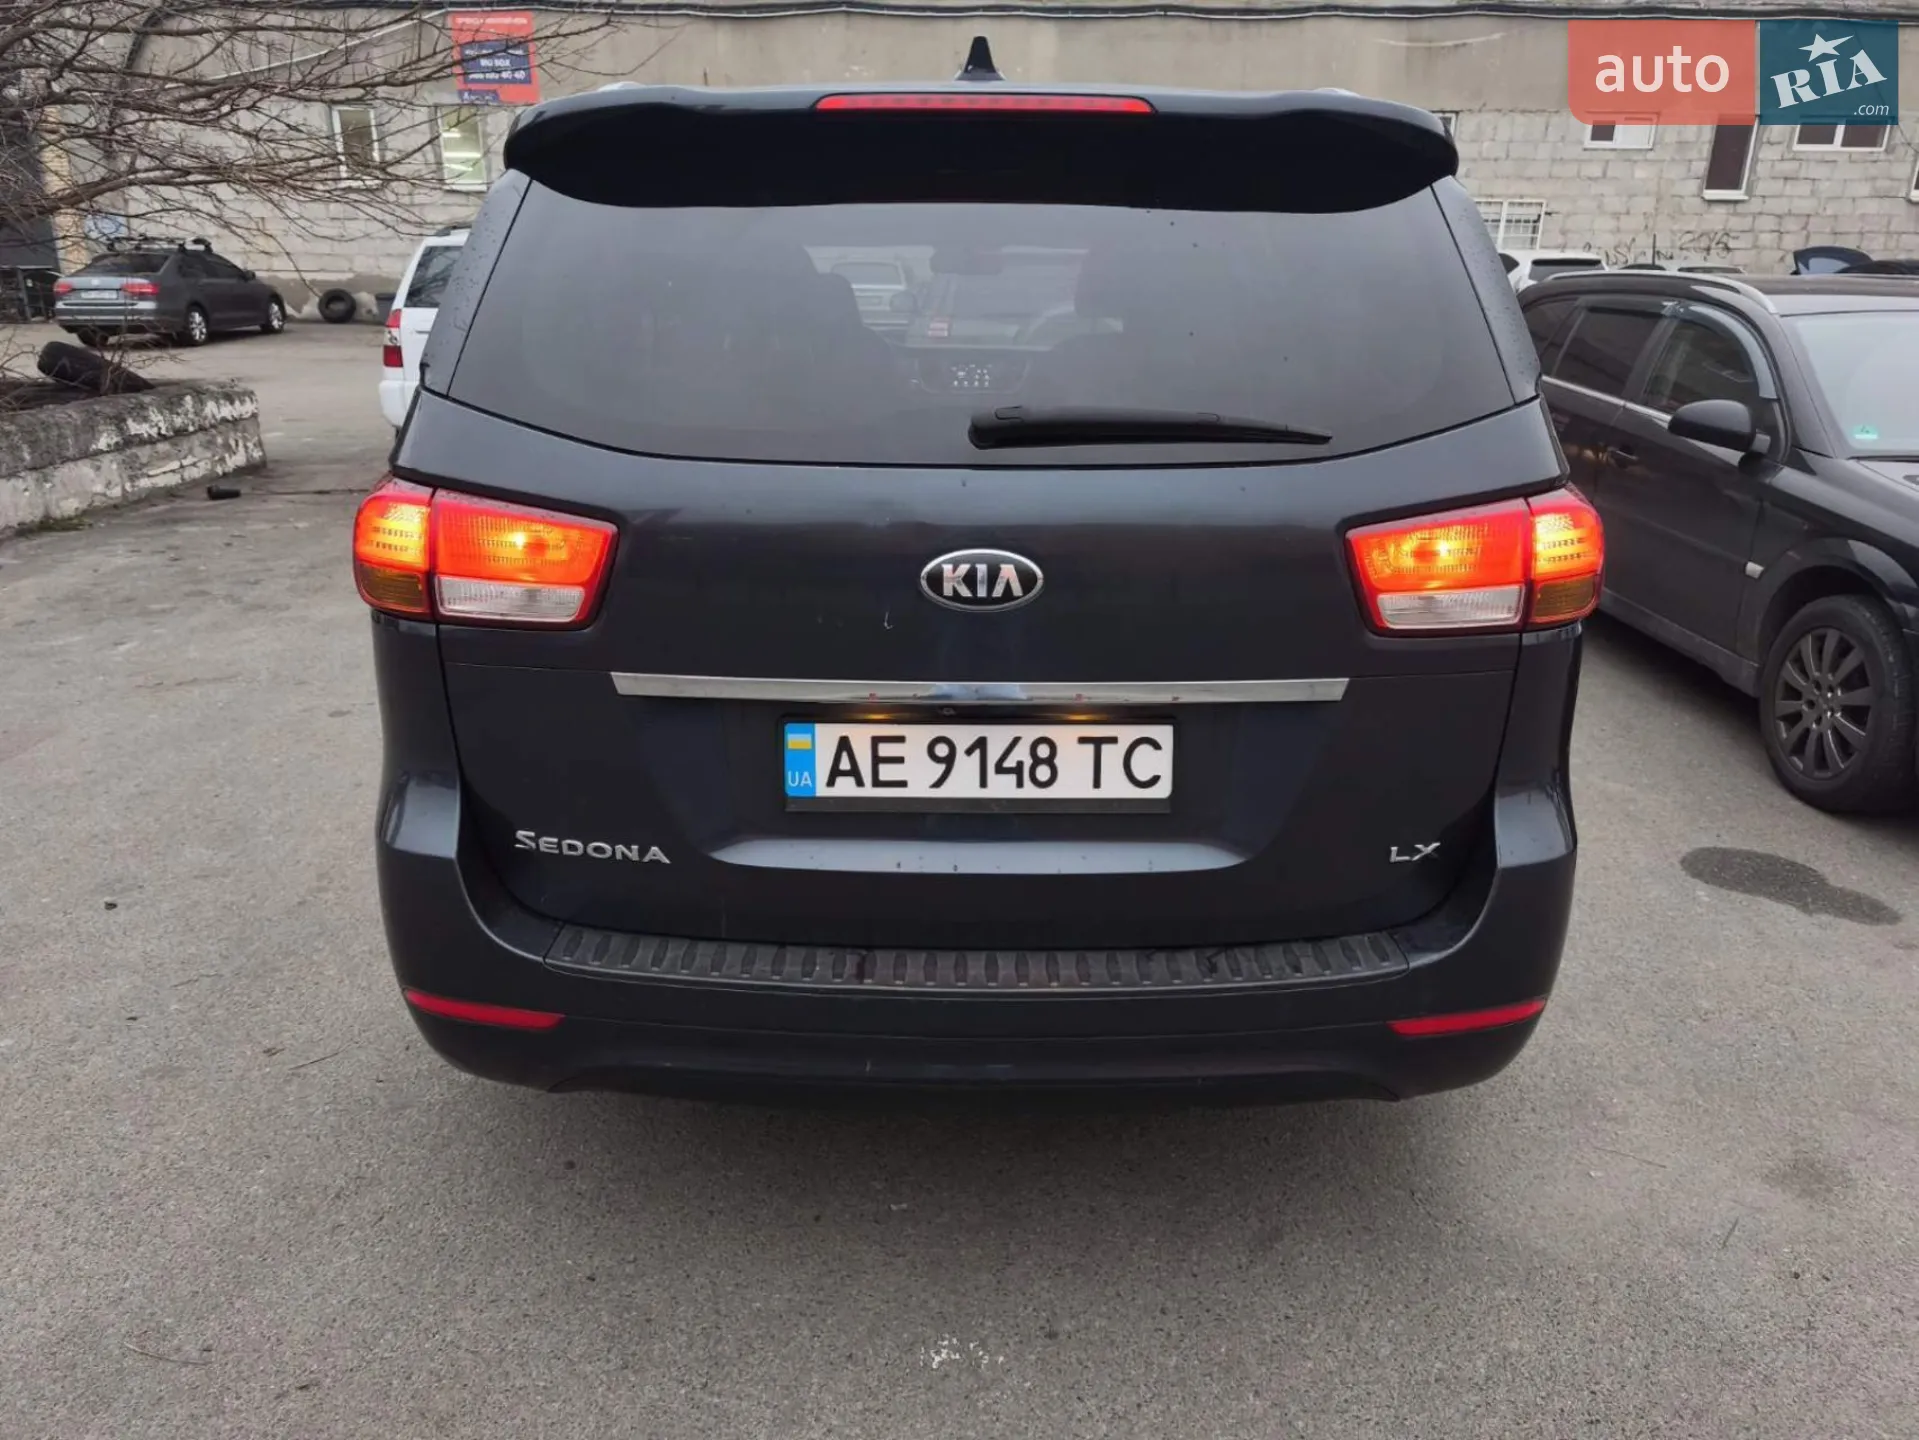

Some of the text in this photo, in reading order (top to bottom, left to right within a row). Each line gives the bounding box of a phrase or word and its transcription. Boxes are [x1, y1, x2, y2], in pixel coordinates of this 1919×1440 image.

[940, 562, 1024, 598] KIA
[826, 735, 1163, 789] AE 9148 TC
[787, 771, 812, 788] UA
[1389, 841, 1441, 863] LX
